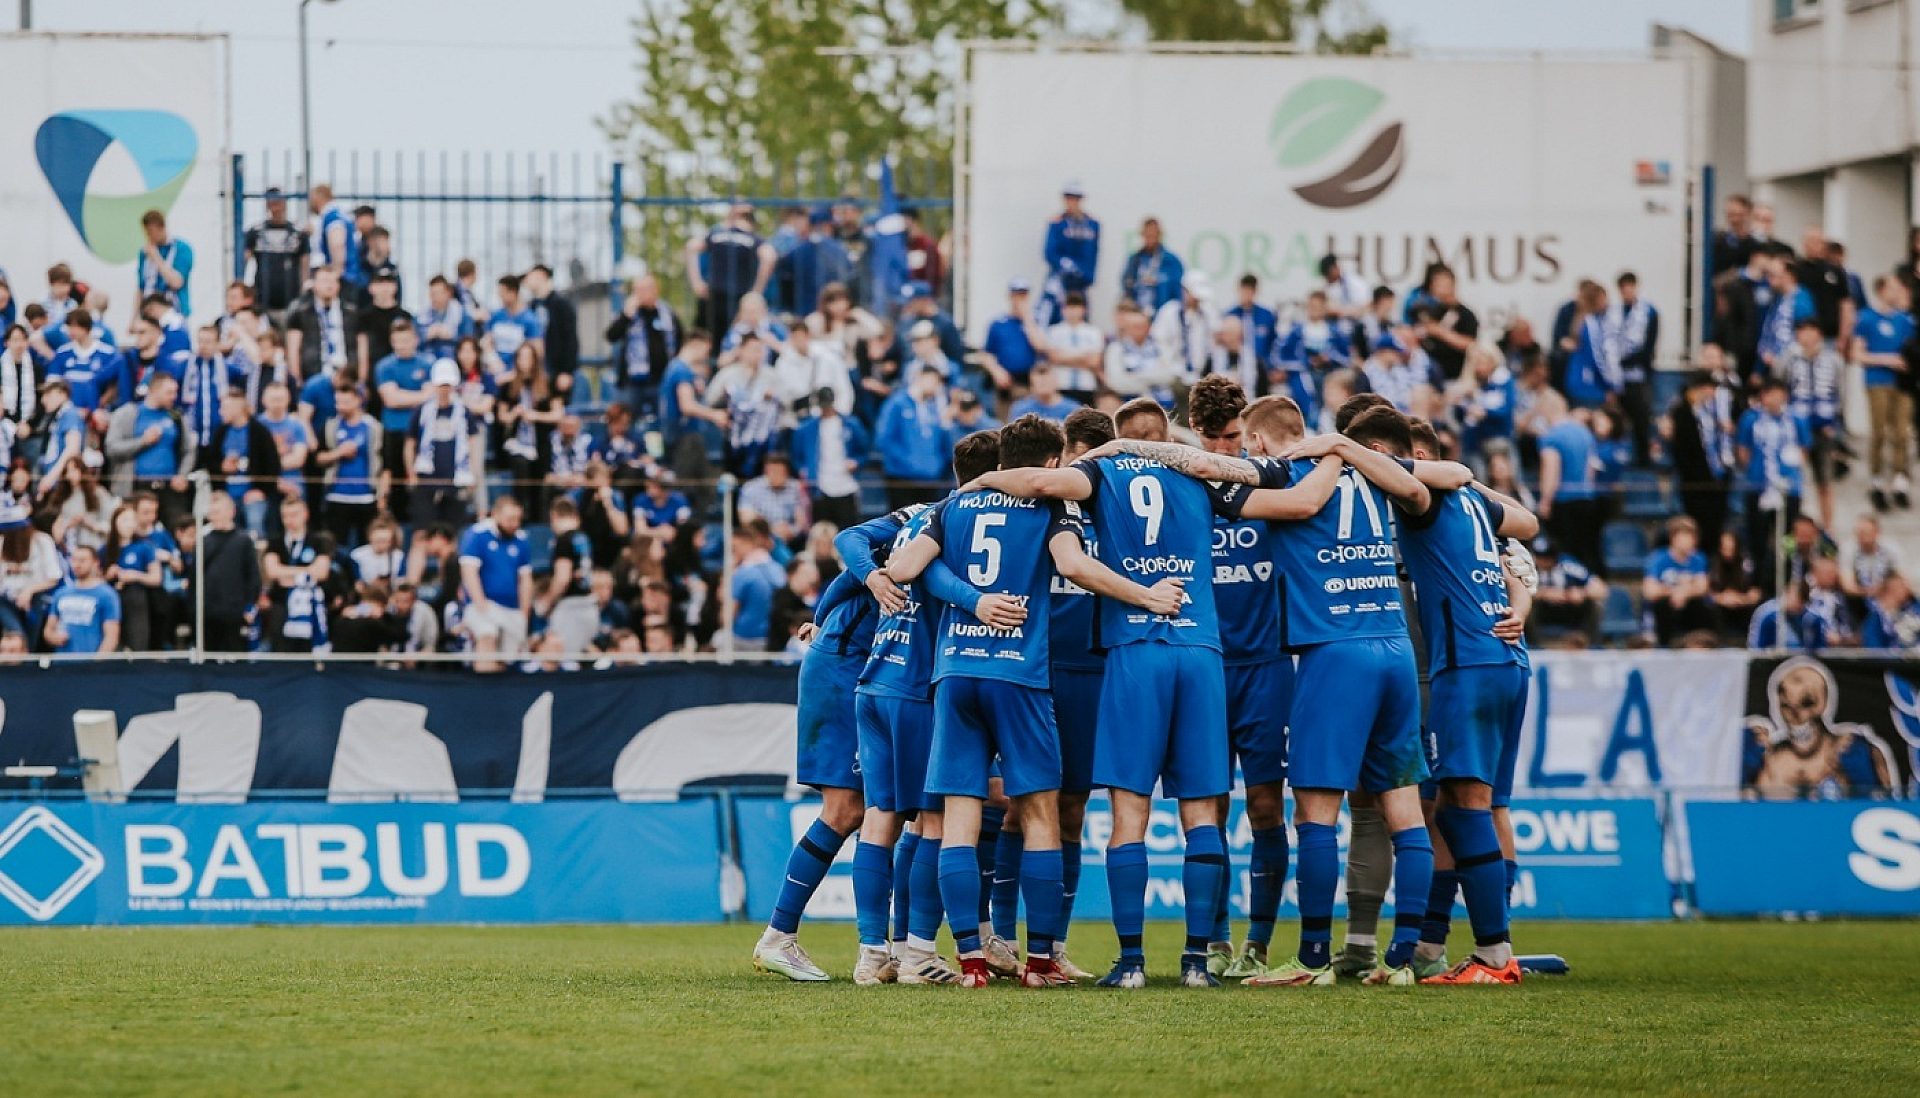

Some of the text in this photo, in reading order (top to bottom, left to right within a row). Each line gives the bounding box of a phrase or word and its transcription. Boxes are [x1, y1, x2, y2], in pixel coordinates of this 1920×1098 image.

[1124, 229, 1562, 284] ORAHUMUS
[1129, 474, 1164, 546] 9
[967, 512, 1008, 587] 5
[124, 821, 532, 898] BATBUD
